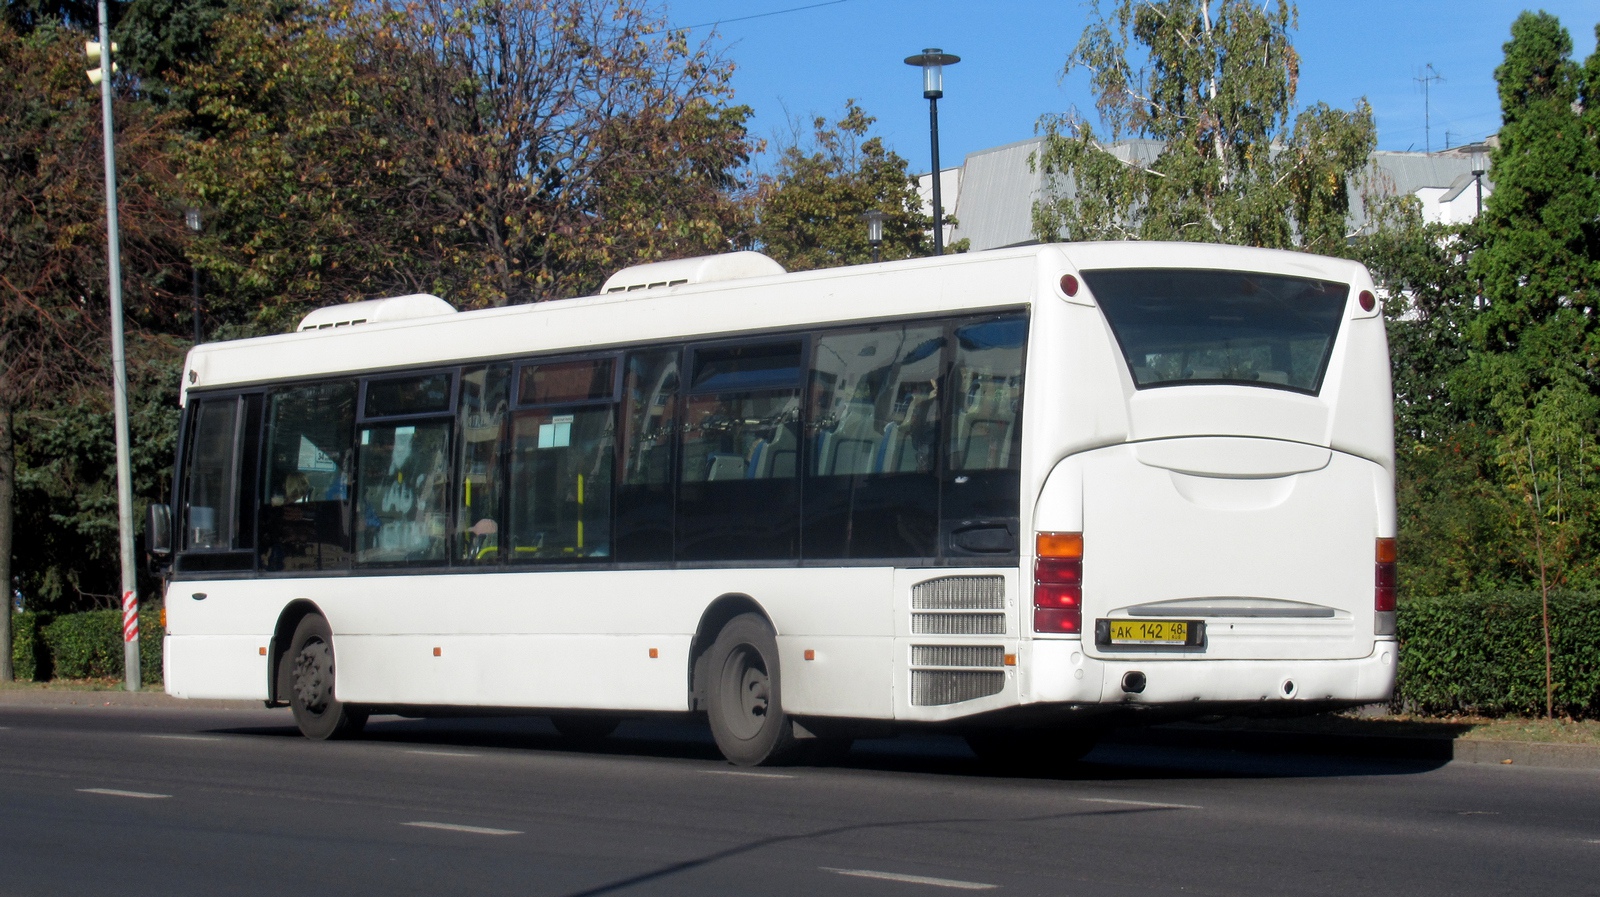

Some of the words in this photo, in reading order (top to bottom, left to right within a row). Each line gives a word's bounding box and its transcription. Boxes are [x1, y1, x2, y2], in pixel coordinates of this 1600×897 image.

[1117, 626, 1132, 638] AK
[1140, 623, 1163, 639] 142
[1170, 623, 1183, 635] 48
